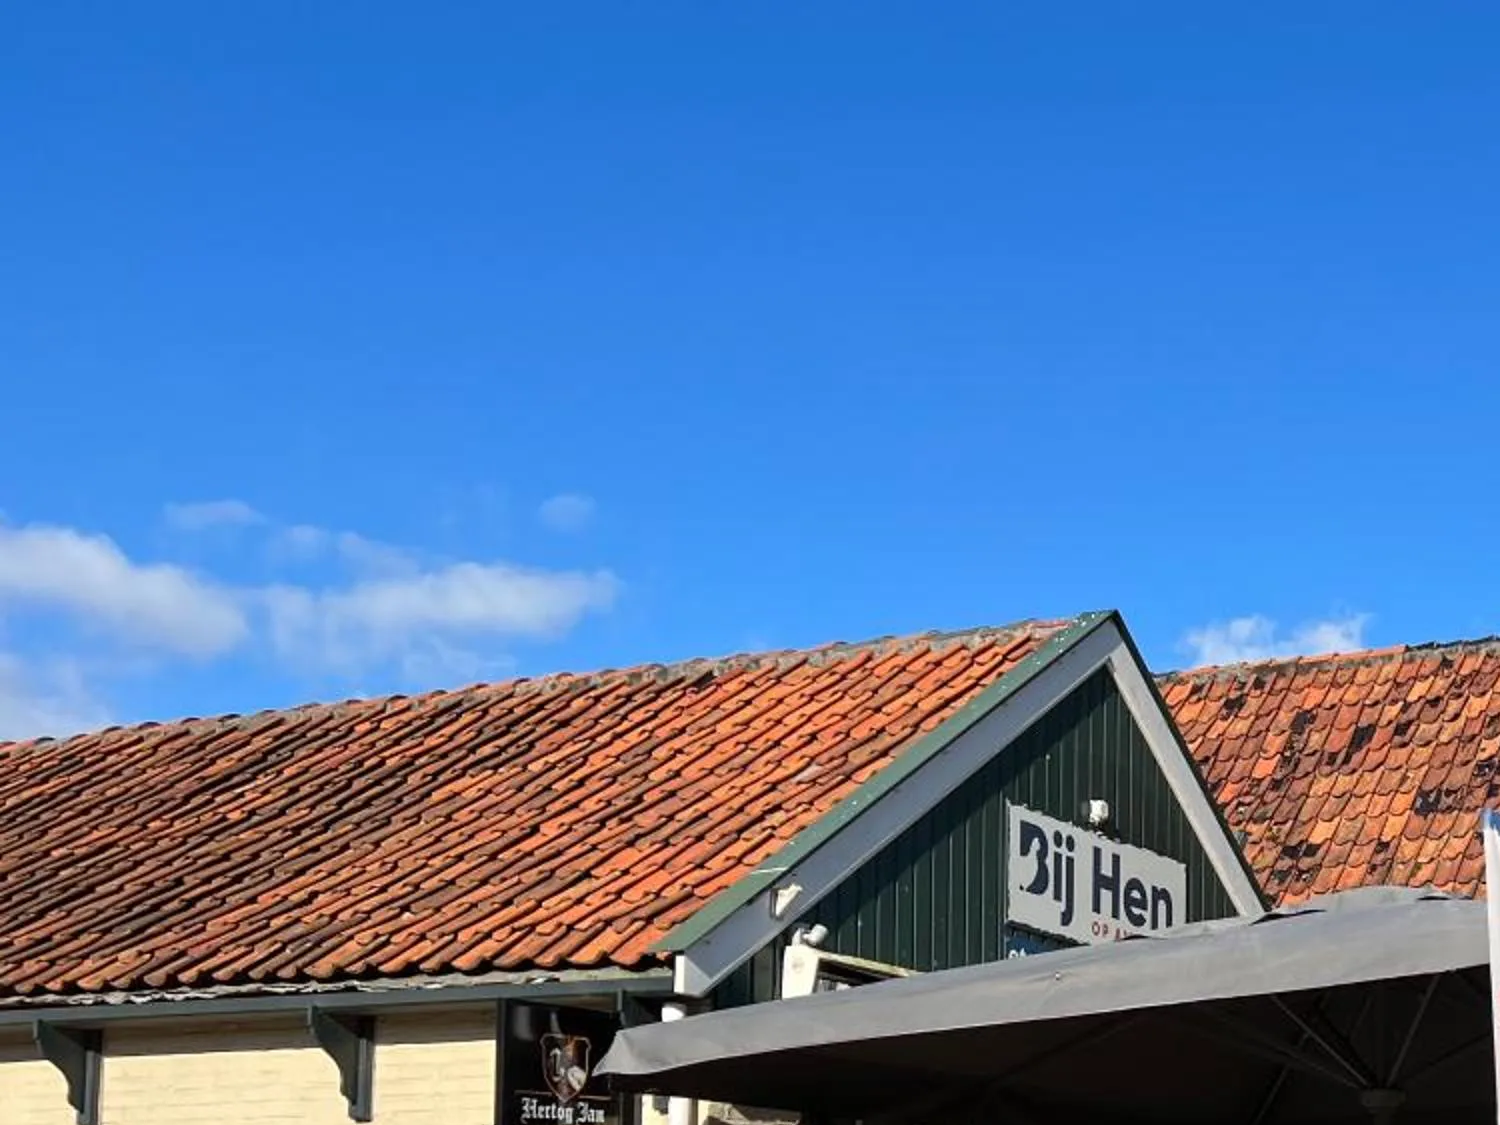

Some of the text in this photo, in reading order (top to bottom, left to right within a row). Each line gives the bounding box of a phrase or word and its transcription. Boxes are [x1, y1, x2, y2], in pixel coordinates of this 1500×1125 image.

[1019, 819, 1173, 931] Bij Hen
[520, 1096, 574, 1125] Hertog
